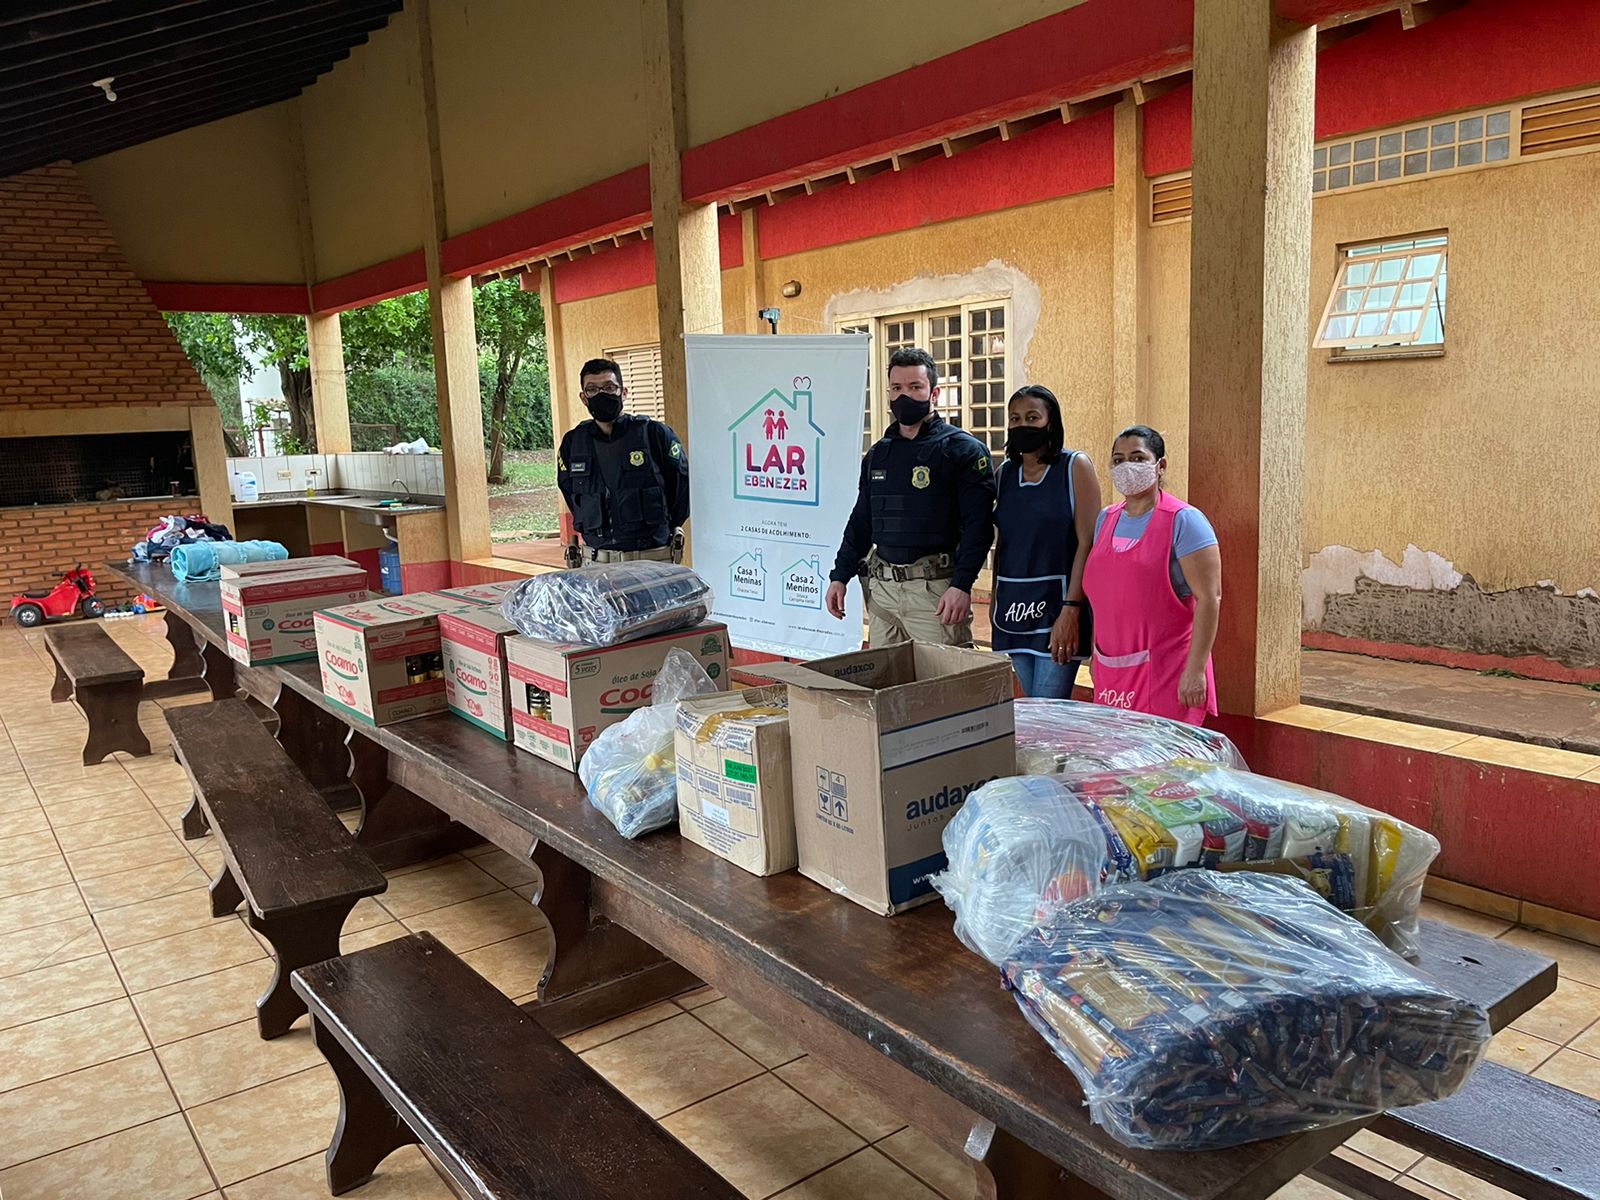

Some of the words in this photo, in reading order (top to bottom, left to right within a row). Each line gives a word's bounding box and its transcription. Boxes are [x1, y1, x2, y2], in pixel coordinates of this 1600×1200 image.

[746, 443, 805, 475] LAR
[745, 475, 807, 491] EBENEZER
[745, 526, 760, 534] CASAS
[737, 566, 753, 576] Casa
[734, 574, 762, 586] Meninas
[790, 573, 808, 584] Casa
[809, 576, 814, 584] 2
[785, 582, 819, 594] Meninos
[1005, 601, 1046, 622] ADAS
[325, 650, 358, 674] Coamo
[575, 665, 580, 674] 5
[834, 661, 875, 678] audaxco
[456, 667, 487, 691] Coamo
[611, 674, 628, 685] Óleo
[629, 673, 639, 681] de
[1098, 688, 1135, 709] ADAS
